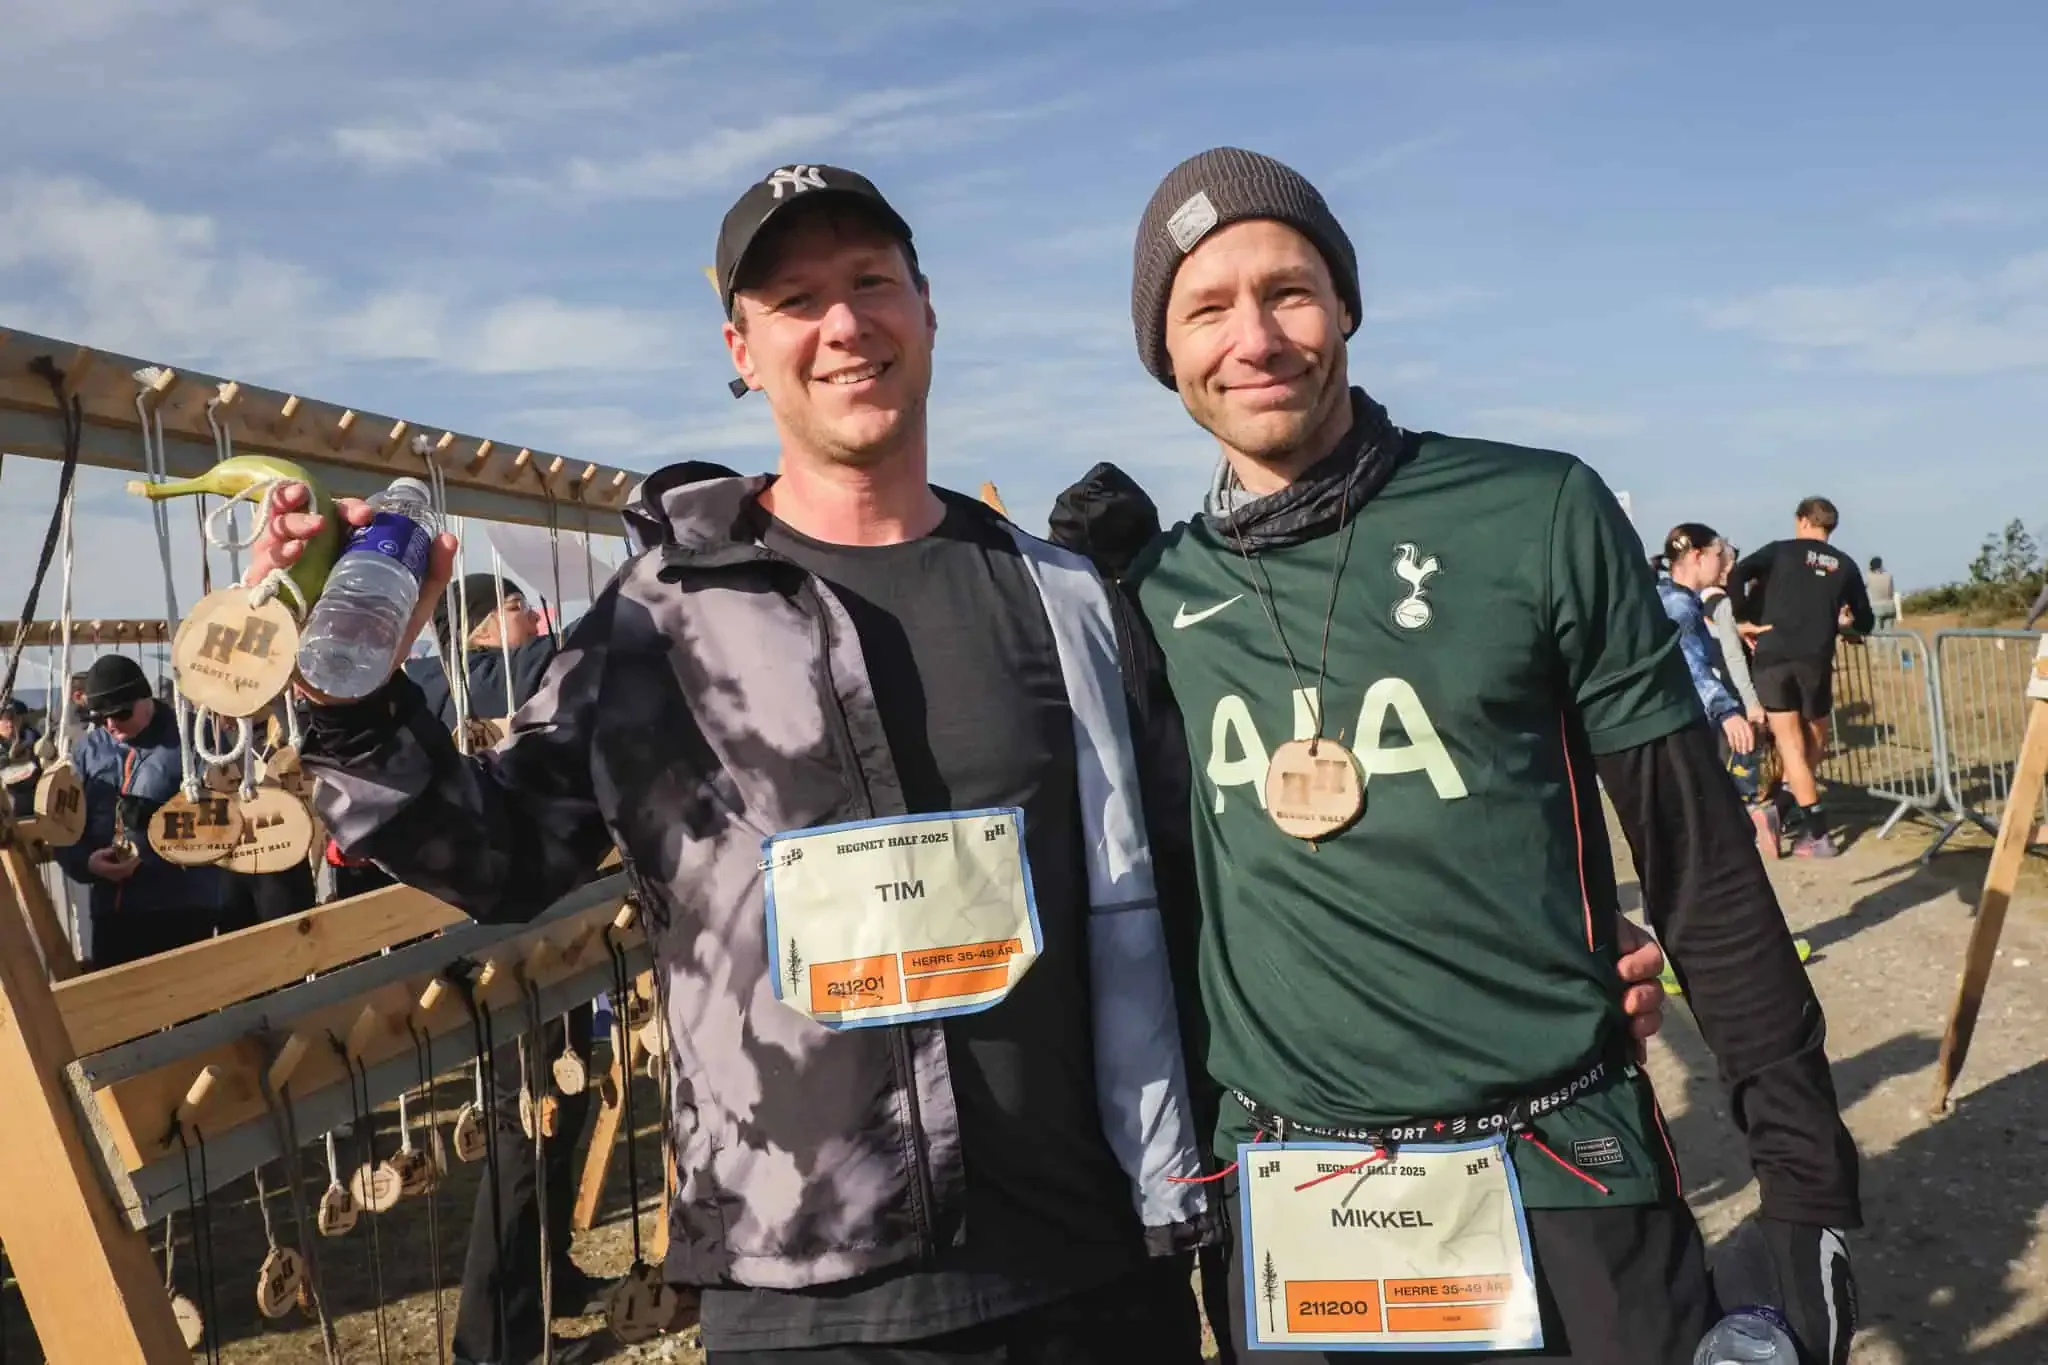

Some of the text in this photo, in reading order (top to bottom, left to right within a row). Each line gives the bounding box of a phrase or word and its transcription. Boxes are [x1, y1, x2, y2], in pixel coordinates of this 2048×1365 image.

[836, 832, 949, 855] HEGNET HALF 2025
[875, 880, 925, 902] TIM
[912, 953, 954, 968] HERRE
[957, 949, 994, 962] 35-49
[827, 976, 884, 996] 211201
[1399, 1166, 1426, 1176] 2025
[1331, 1208, 1433, 1228] MIKKEL
[1394, 1285, 1438, 1297] HERRE
[1299, 1300, 1368, 1316] 211200
